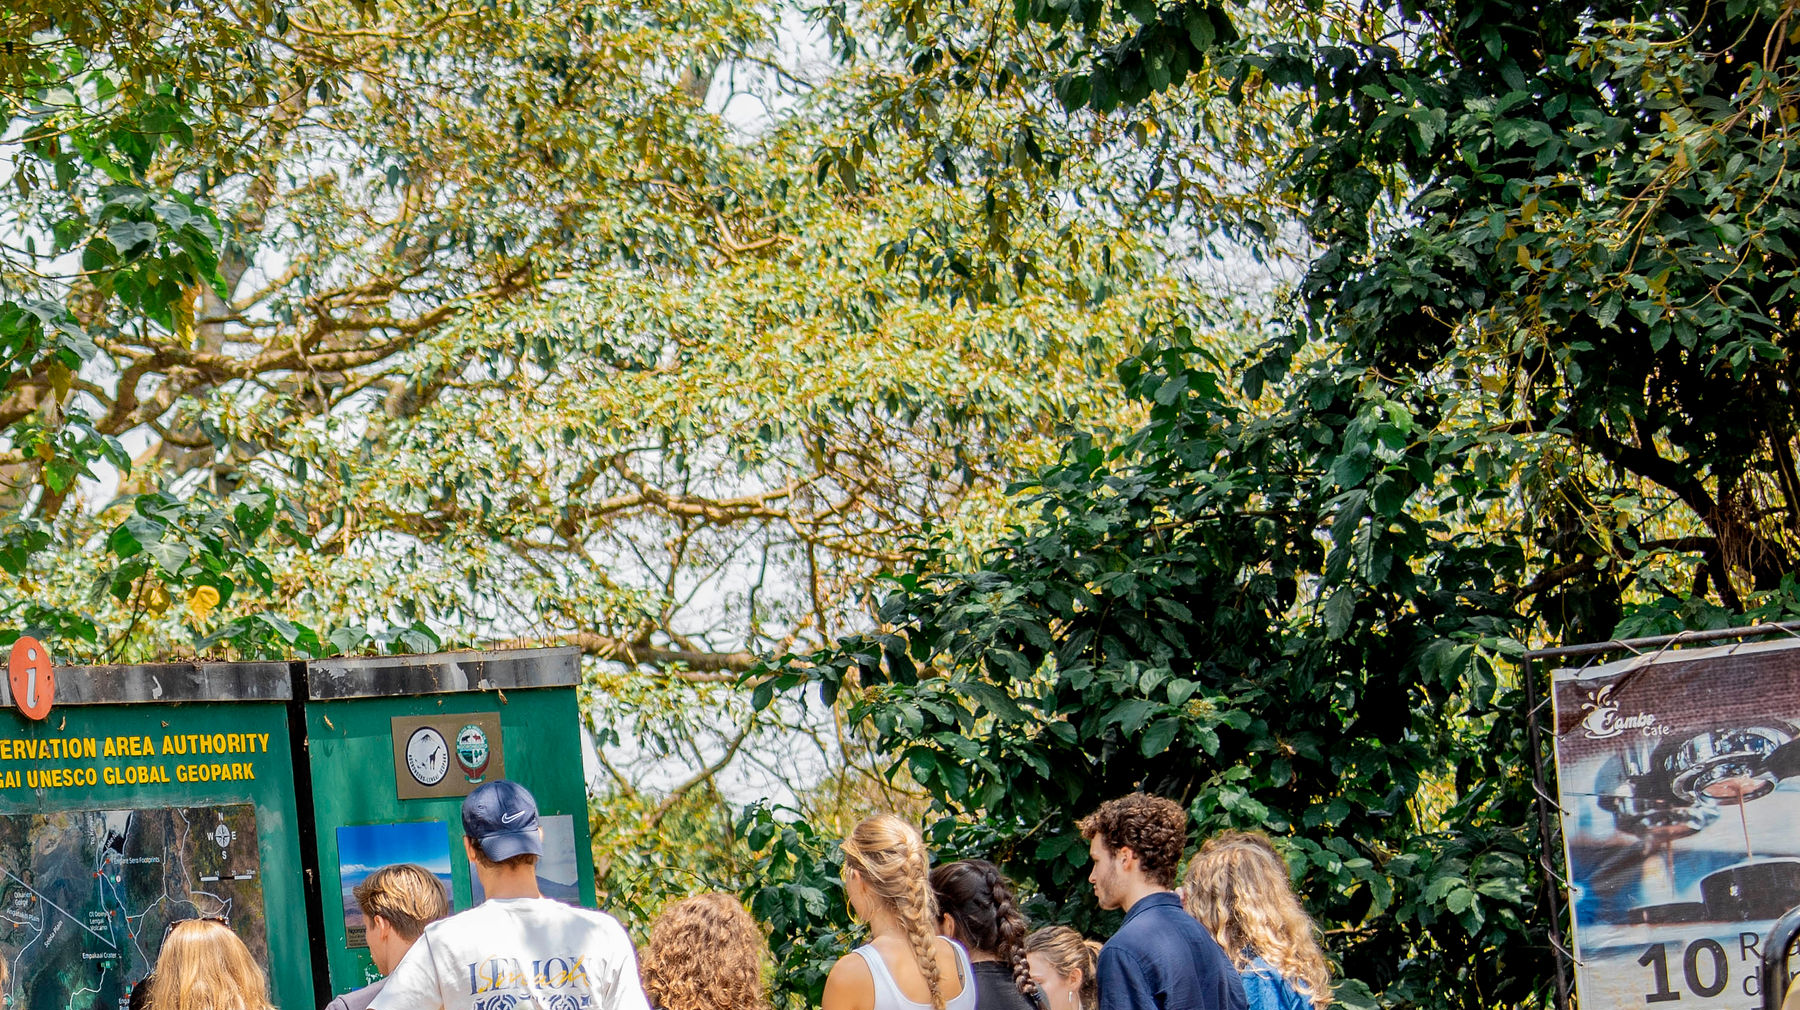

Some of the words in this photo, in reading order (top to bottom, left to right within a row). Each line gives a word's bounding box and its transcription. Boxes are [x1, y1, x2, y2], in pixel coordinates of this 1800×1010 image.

[1642, 724, 1670, 737] Cafe
[103, 736, 155, 757] AREA
[162, 733, 269, 756] AUTHORITY
[26, 768, 98, 788] UNESCO
[103, 765, 170, 785] GLOBAL
[175, 763, 255, 783] GEOPARK
[1637, 938, 1729, 1004] 10
